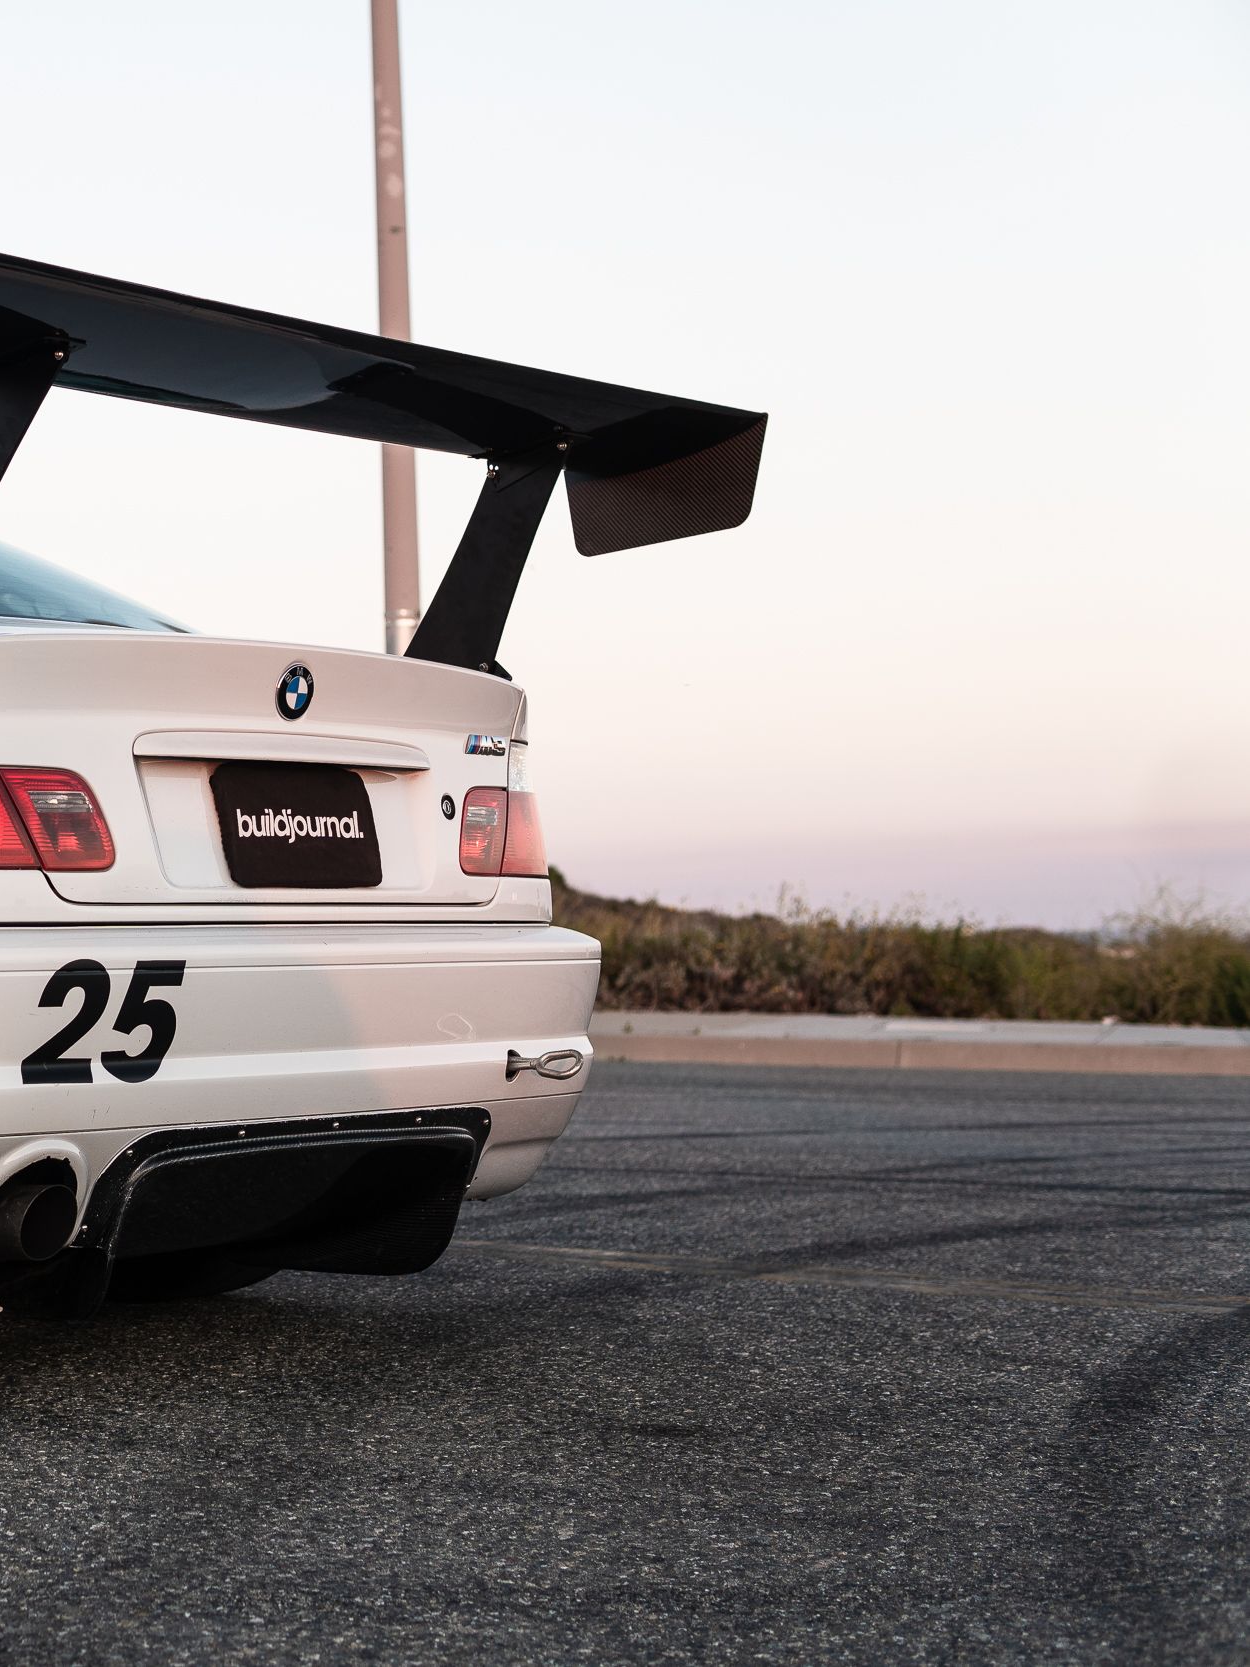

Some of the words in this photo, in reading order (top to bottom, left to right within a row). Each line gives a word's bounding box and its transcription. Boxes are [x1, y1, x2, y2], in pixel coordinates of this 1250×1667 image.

[285, 666, 313, 685] BMW
[236, 808, 364, 844] buildjournal.
[21, 958, 187, 1084] 25
